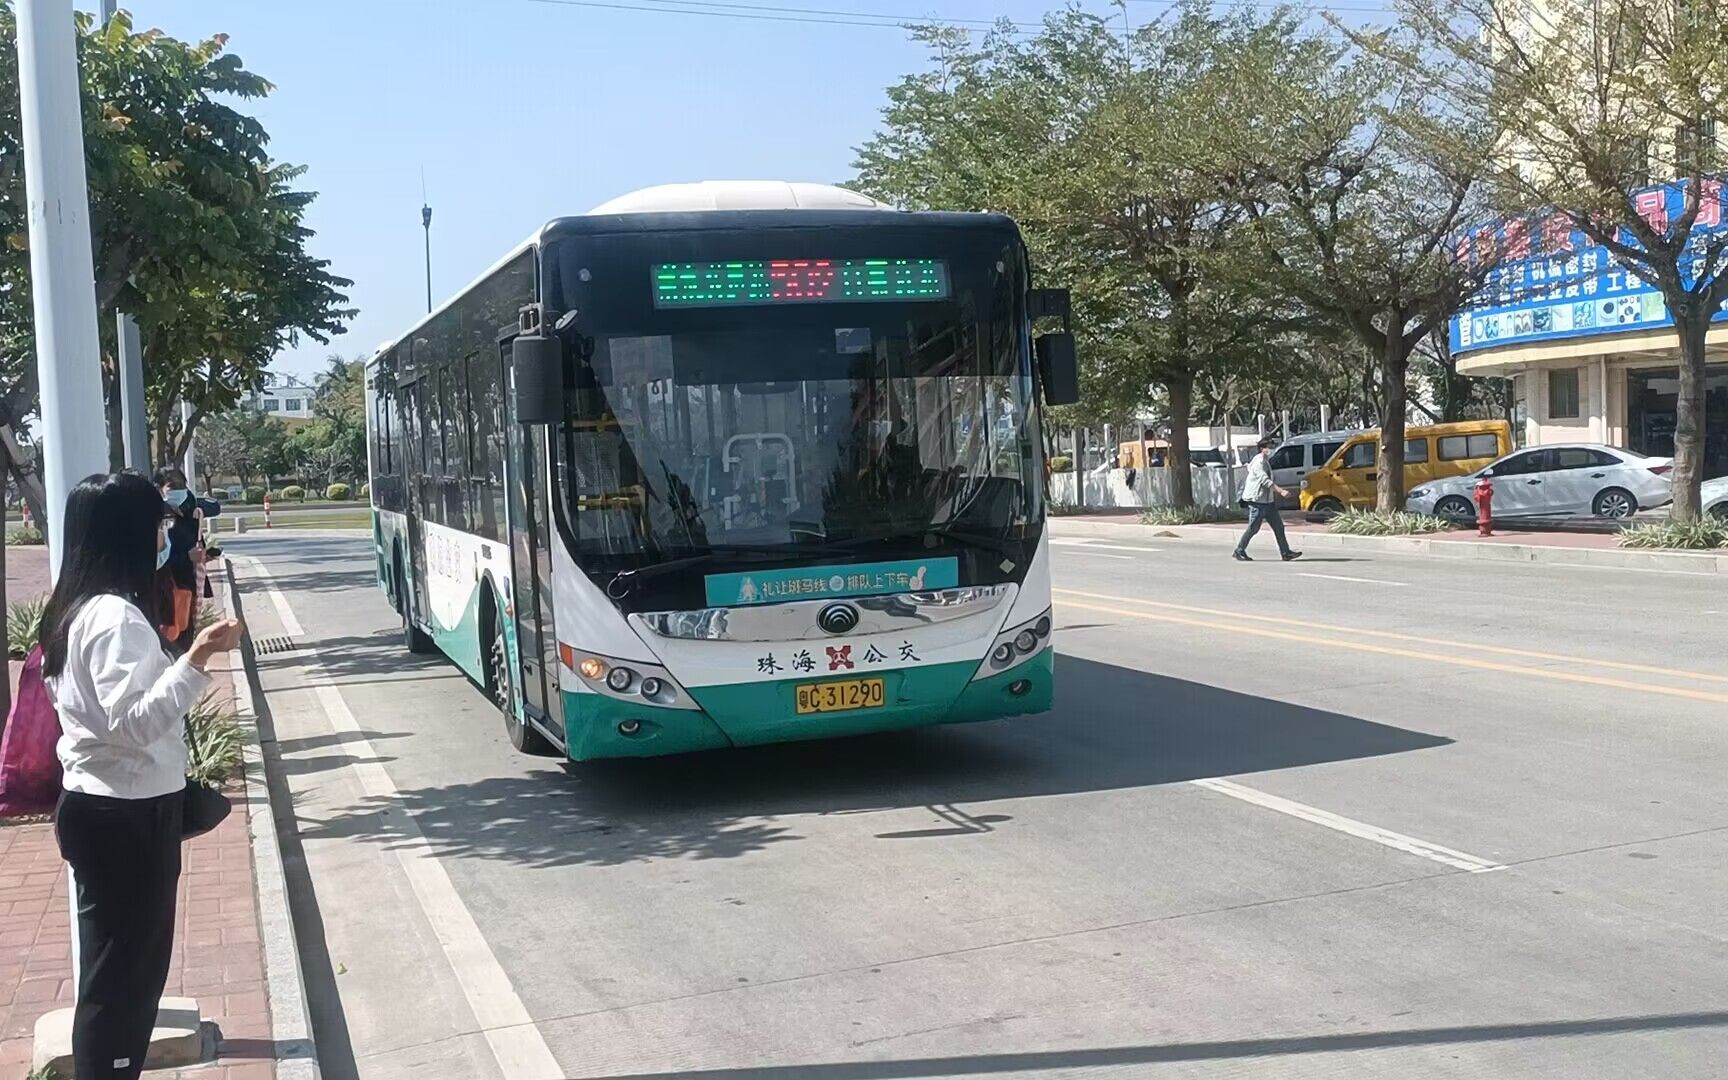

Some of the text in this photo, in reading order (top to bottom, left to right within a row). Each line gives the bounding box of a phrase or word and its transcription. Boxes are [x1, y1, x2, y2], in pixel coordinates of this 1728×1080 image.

[762, 573, 909, 597] 礼让斑马线 排队上下车
[757, 640, 921, 675] 珠海 公交
